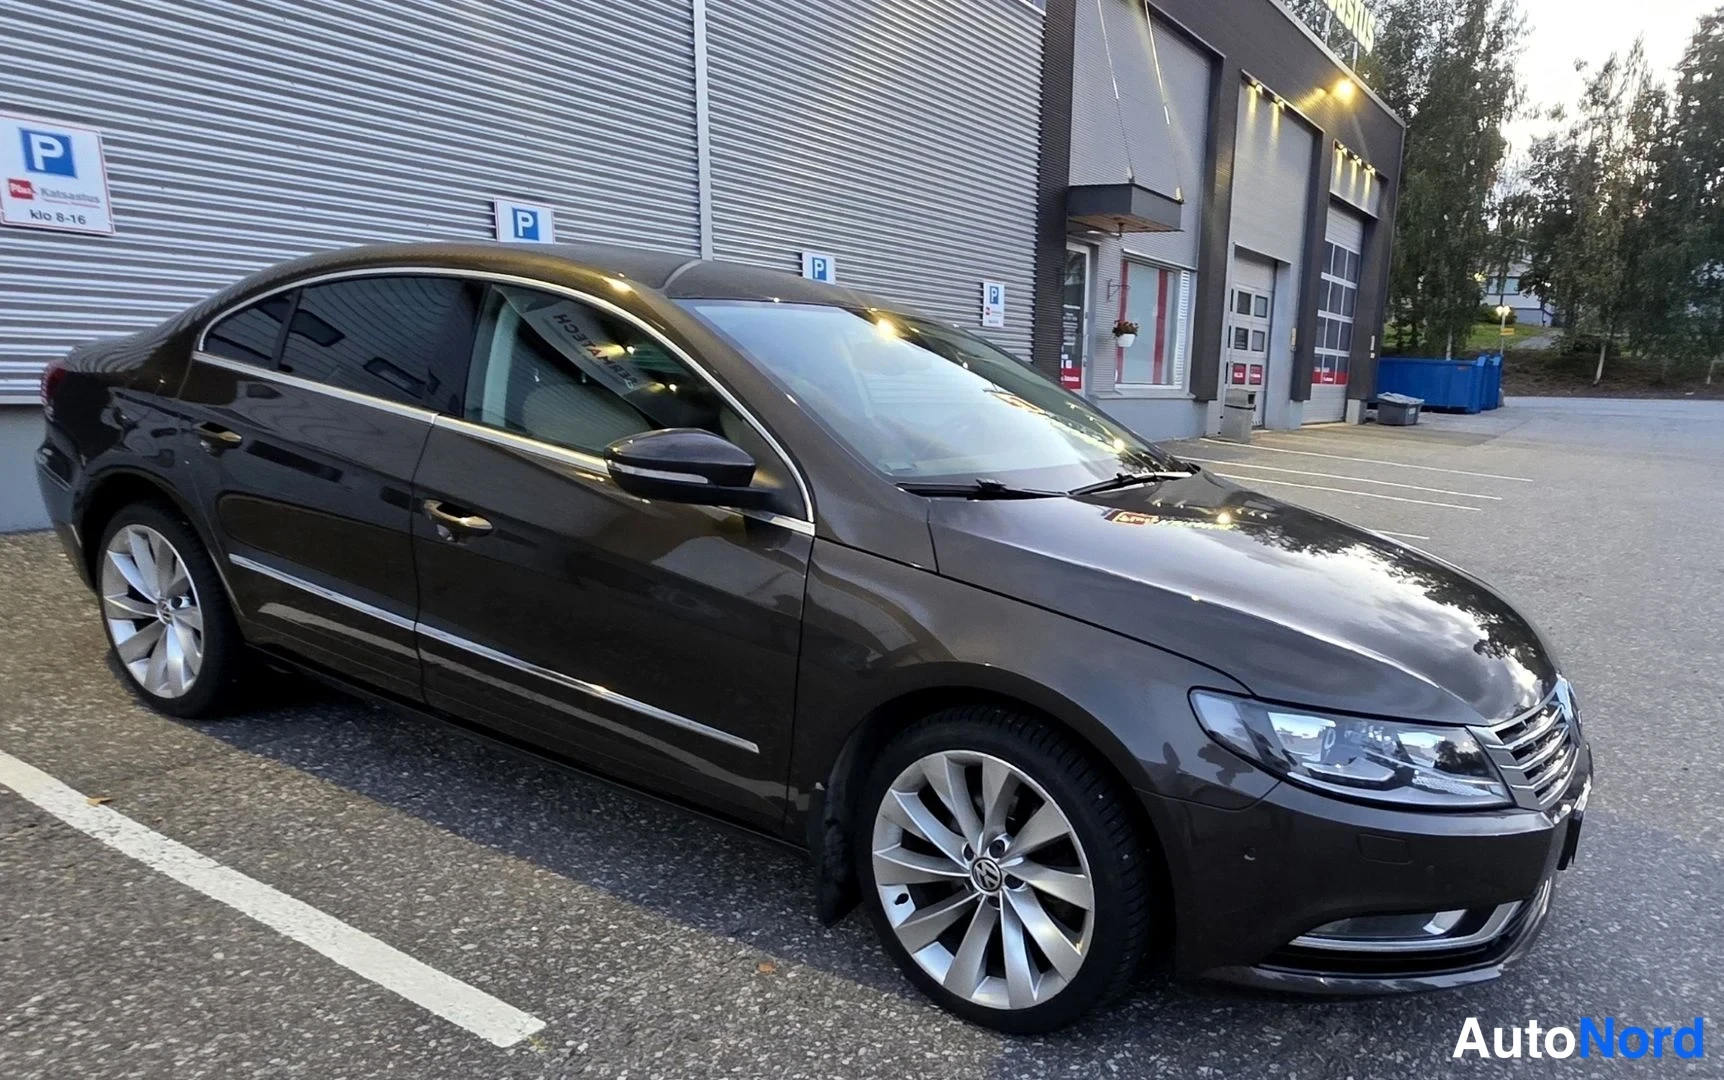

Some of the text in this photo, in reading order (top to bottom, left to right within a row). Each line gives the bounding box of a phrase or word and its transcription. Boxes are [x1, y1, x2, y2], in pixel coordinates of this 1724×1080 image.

[29, 133, 64, 170] P
[29, 209, 86, 225] klo 8-16
[516, 211, 534, 237] P
[814, 258, 825, 279] P
[991, 287, 998, 303] P
